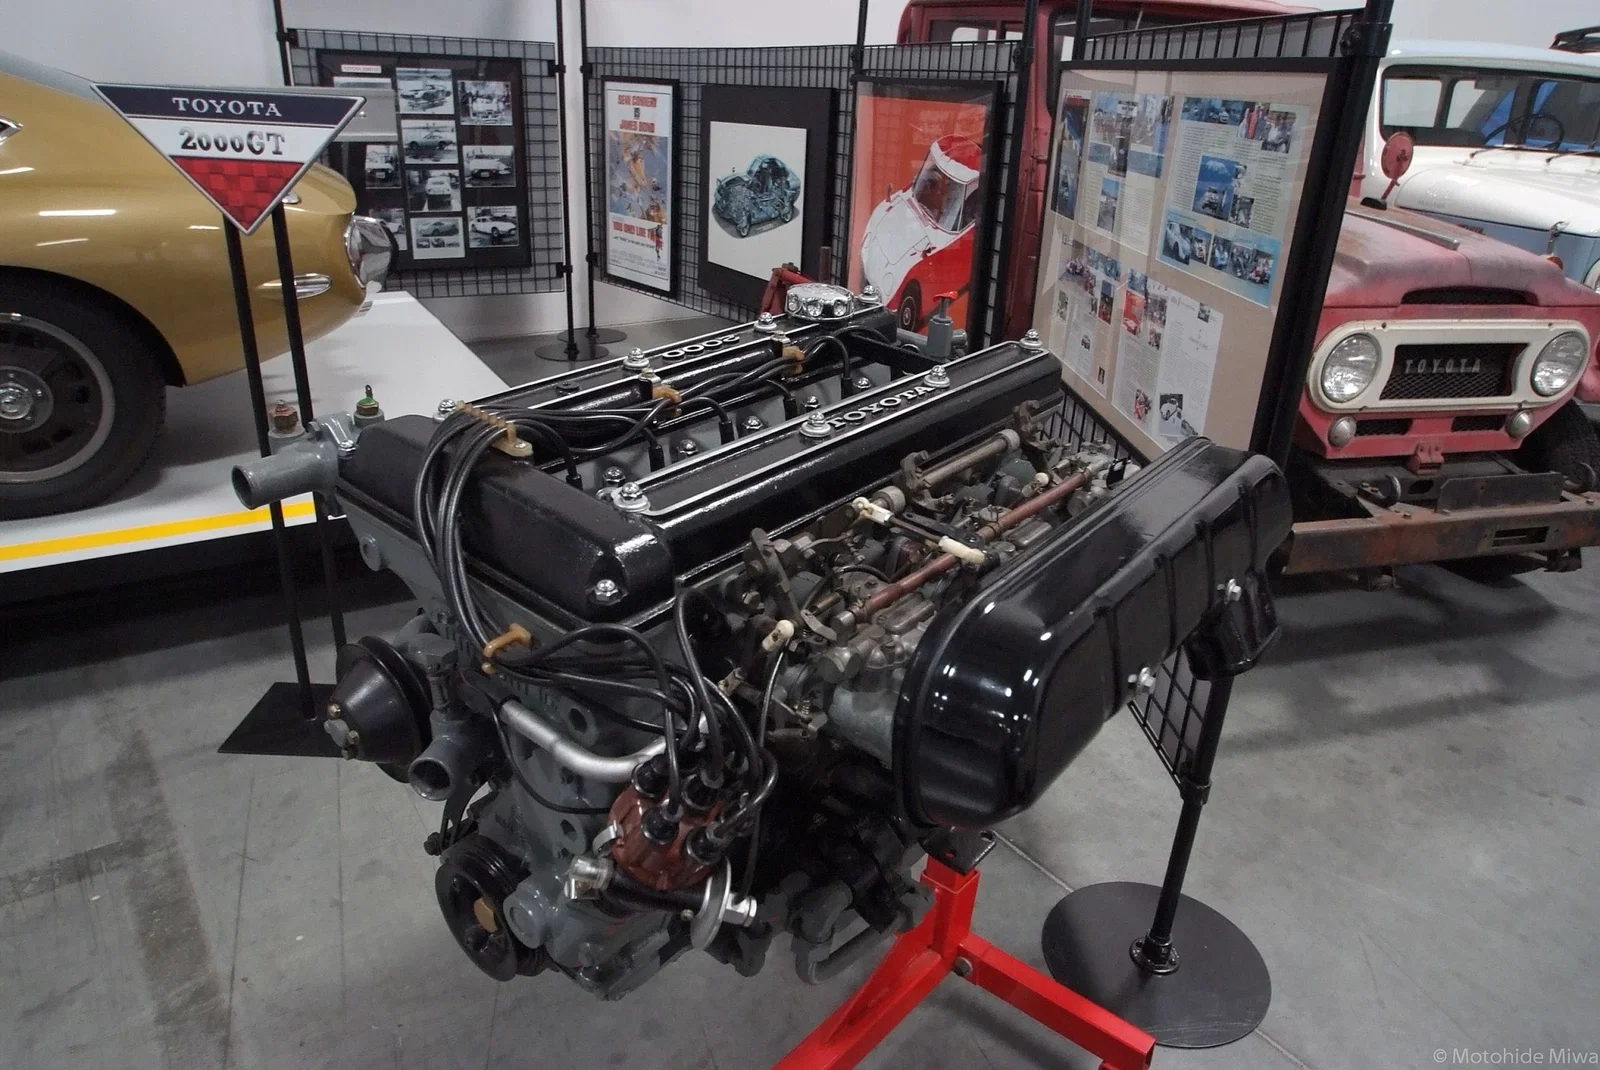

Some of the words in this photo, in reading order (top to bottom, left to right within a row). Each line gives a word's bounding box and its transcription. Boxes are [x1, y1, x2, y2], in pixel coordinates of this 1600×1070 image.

[172, 97, 282, 117] TOYOTA
[179, 126, 285, 155] 2000GT
[662, 334, 740, 358] 2000
[1405, 358, 1480, 374] TOYOTA
[826, 385, 936, 428] TOYOTA
